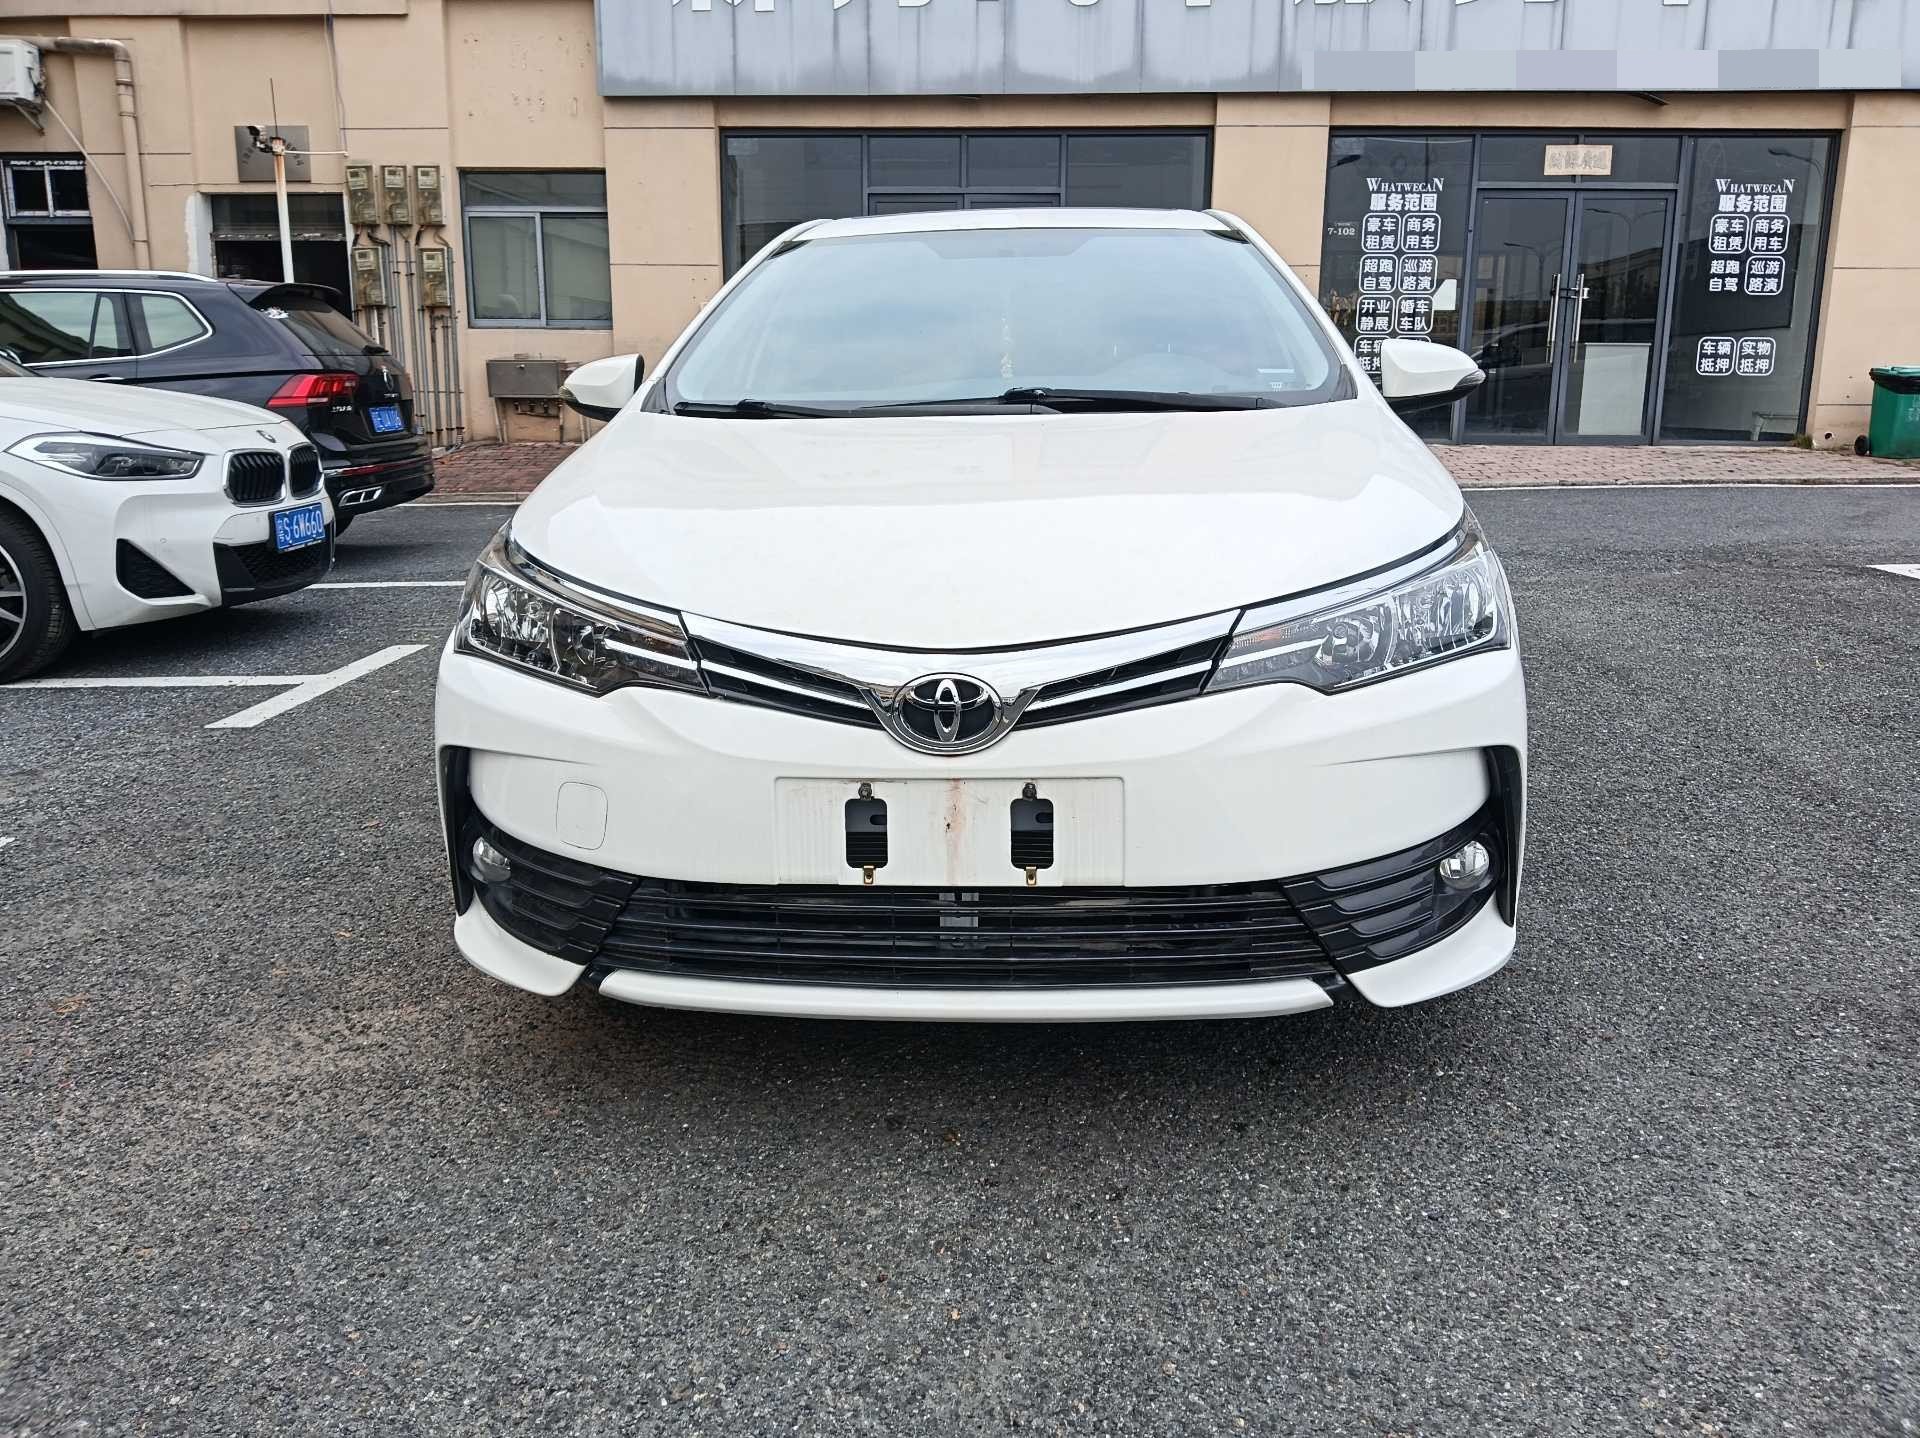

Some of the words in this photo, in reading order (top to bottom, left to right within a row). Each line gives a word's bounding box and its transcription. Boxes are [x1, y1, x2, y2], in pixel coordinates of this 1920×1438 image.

[1369, 193, 1438, 211] 服务范围
[1718, 194, 1788, 213] 服务范围
[1327, 227, 1356, 236] 7-102
[1367, 217, 1396, 232] 豪车
[1407, 217, 1436, 232] 商务
[1715, 218, 1745, 233] 豪车
[1755, 218, 1784, 233] 商务
[1365, 235, 1396, 250] 租赁
[1405, 235, 1435, 250] 用车
[1712, 236, 1743, 251] 租赁
[1753, 236, 1783, 251] 用车
[1364, 259, 1393, 273] 超跑
[1403, 259, 1433, 273] 巡游
[1710, 260, 1740, 274] 超跑
[1750, 260, 1780, 275] 巡游
[1363, 276, 1392, 290] 自驾
[1402, 276, 1432, 290] 路演
[1709, 277, 1739, 292] 自驾
[1748, 277, 1779, 292] 路演
[1361, 299, 1391, 314] 开业
[1400, 299, 1430, 314] 婚车
[1360, 316, 1389, 331] 静展
[1399, 316, 1428, 331] 车队
[1702, 341, 1732, 355] 车辆
[1741, 341, 1771, 356] 实物
[1700, 358, 1730, 373] 抵押
[1739, 358, 1770, 373] 抵押
